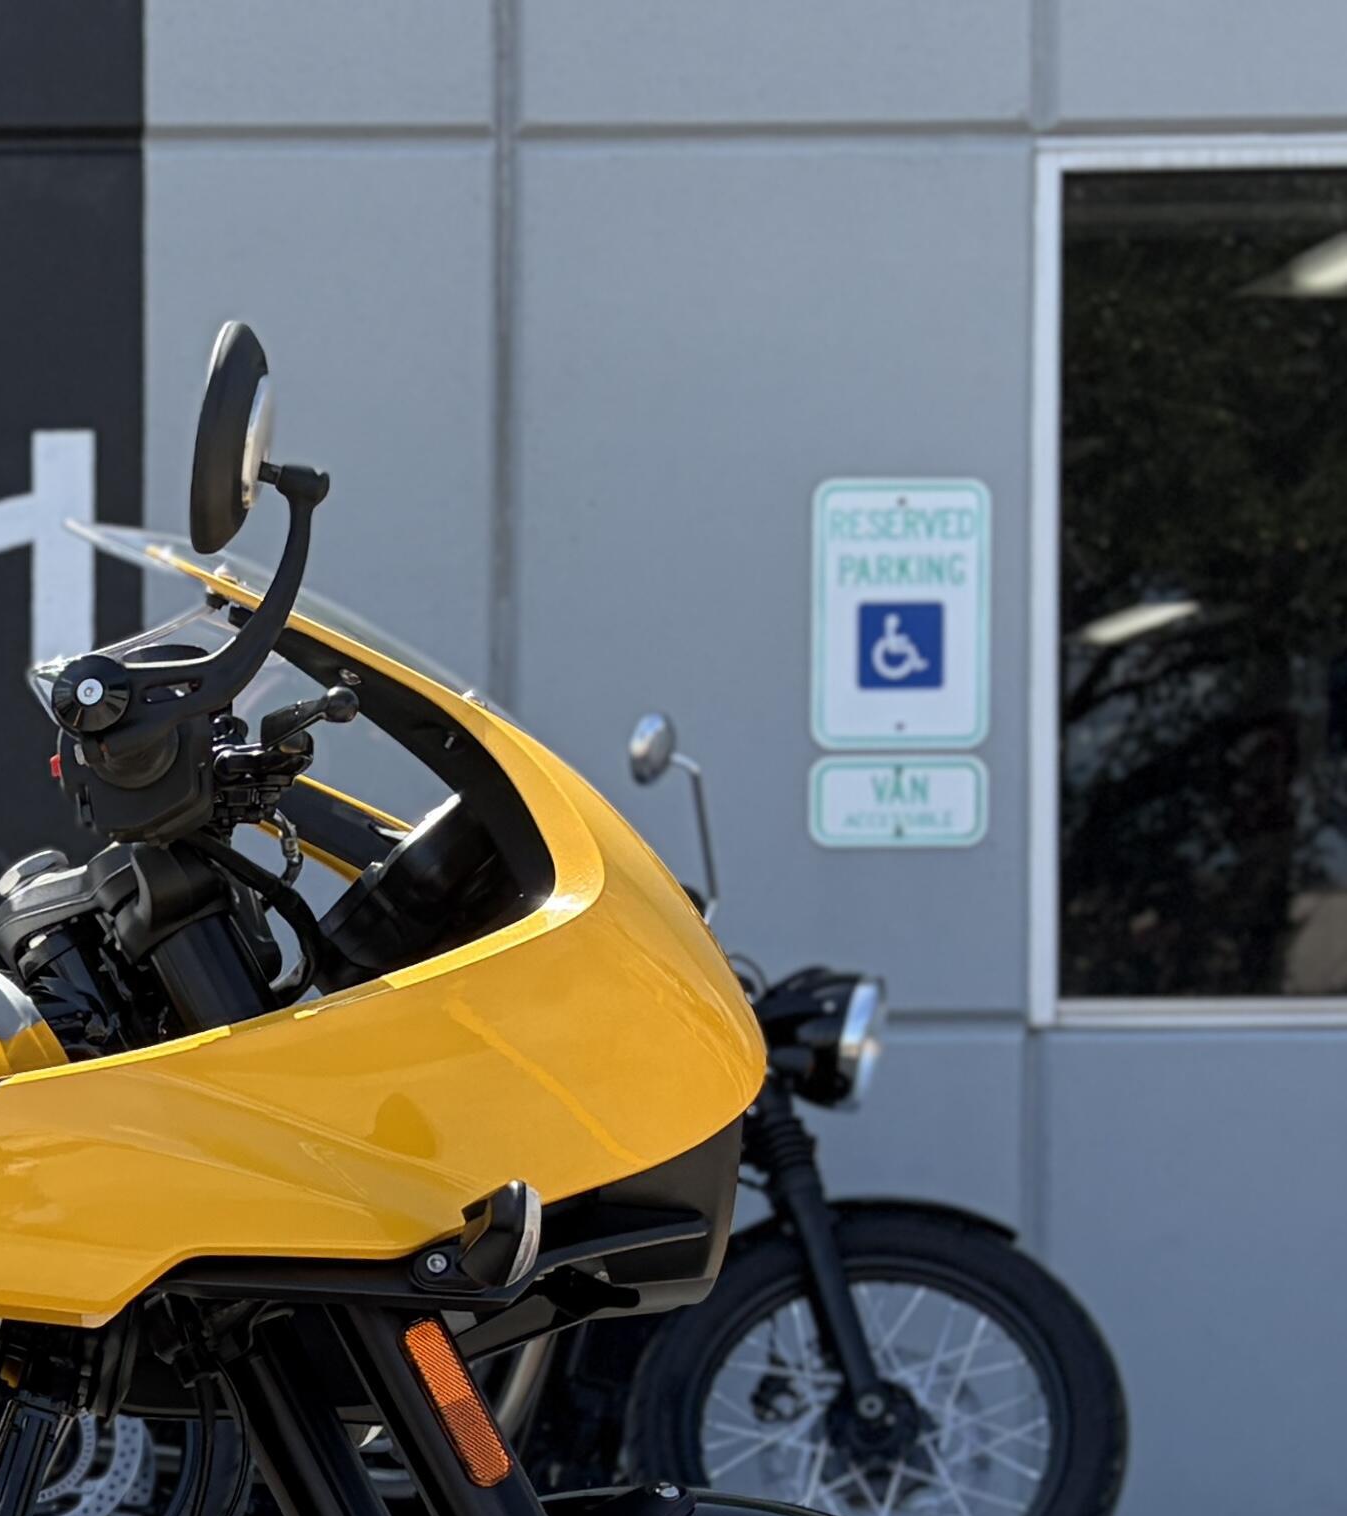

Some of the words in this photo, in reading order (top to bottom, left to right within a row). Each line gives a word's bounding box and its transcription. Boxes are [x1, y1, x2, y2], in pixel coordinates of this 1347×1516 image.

[829, 508, 976, 541] RESERVED
[838, 553, 966, 587] PARKING
[871, 774, 930, 805] VAN
